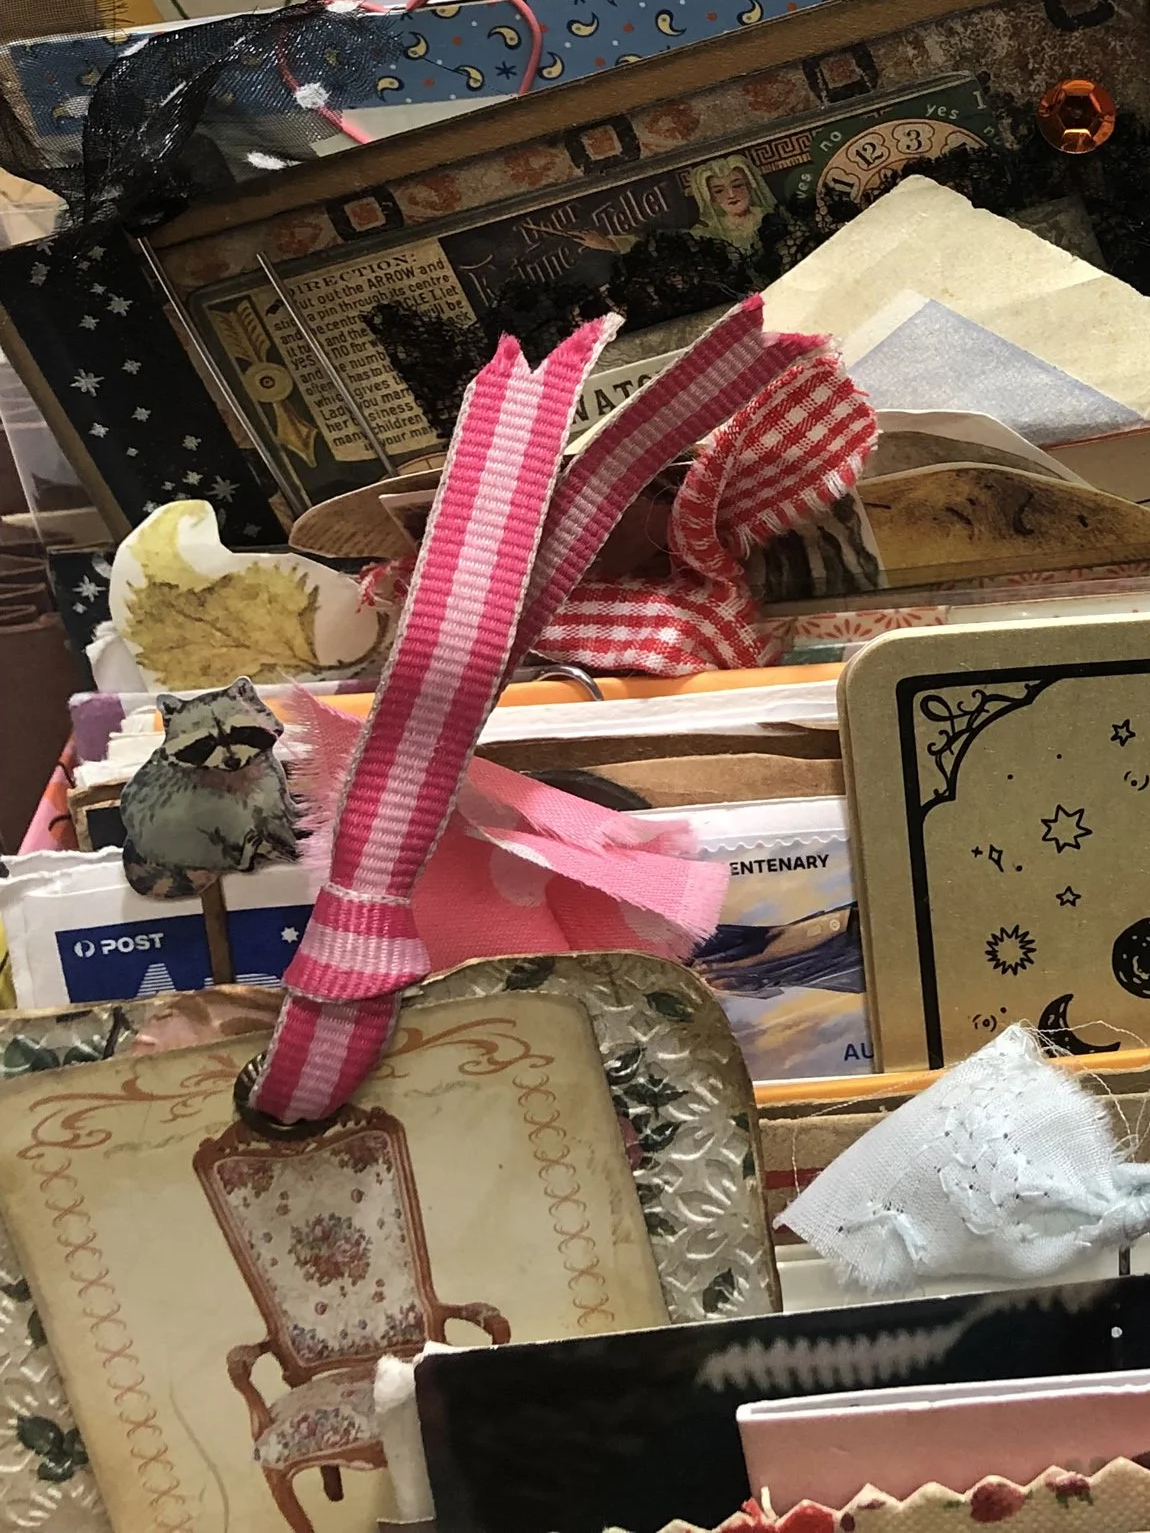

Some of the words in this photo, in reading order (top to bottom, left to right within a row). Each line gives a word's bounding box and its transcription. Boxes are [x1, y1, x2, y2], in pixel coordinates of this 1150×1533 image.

[925, 103, 960, 121] yes
[820, 131, 842, 152] no
[906, 129, 922, 152] 3
[854, 142, 884, 168] 12
[592, 180, 671, 237] Teller
[293, 297, 316, 310] ut
[317, 289, 342, 305] out
[342, 283, 365, 298] the
[367, 266, 415, 290] ARROW
[417, 258, 445, 275] and
[306, 312, 317, 322] a
[317, 306, 338, 322] pin
[339, 289, 389, 313] through
[388, 286, 406, 298] its
[408, 274, 450, 293] centre
[445, 300, 465, 312] be
[279, 329, 304, 345] and
[325, 331, 348, 347] and
[347, 327, 369, 340] the
[291, 354, 317, 371] yes
[350, 341, 369, 354] for
[299, 367, 324, 384] and
[347, 369, 370, 384] has
[313, 392, 346, 408] whic
[353, 379, 391, 400] gives
[324, 419, 350, 434] her
[350, 401, 415, 428] bsiness
[729, 854, 830, 877] ENTENARY
[100, 932, 164, 956] POST
